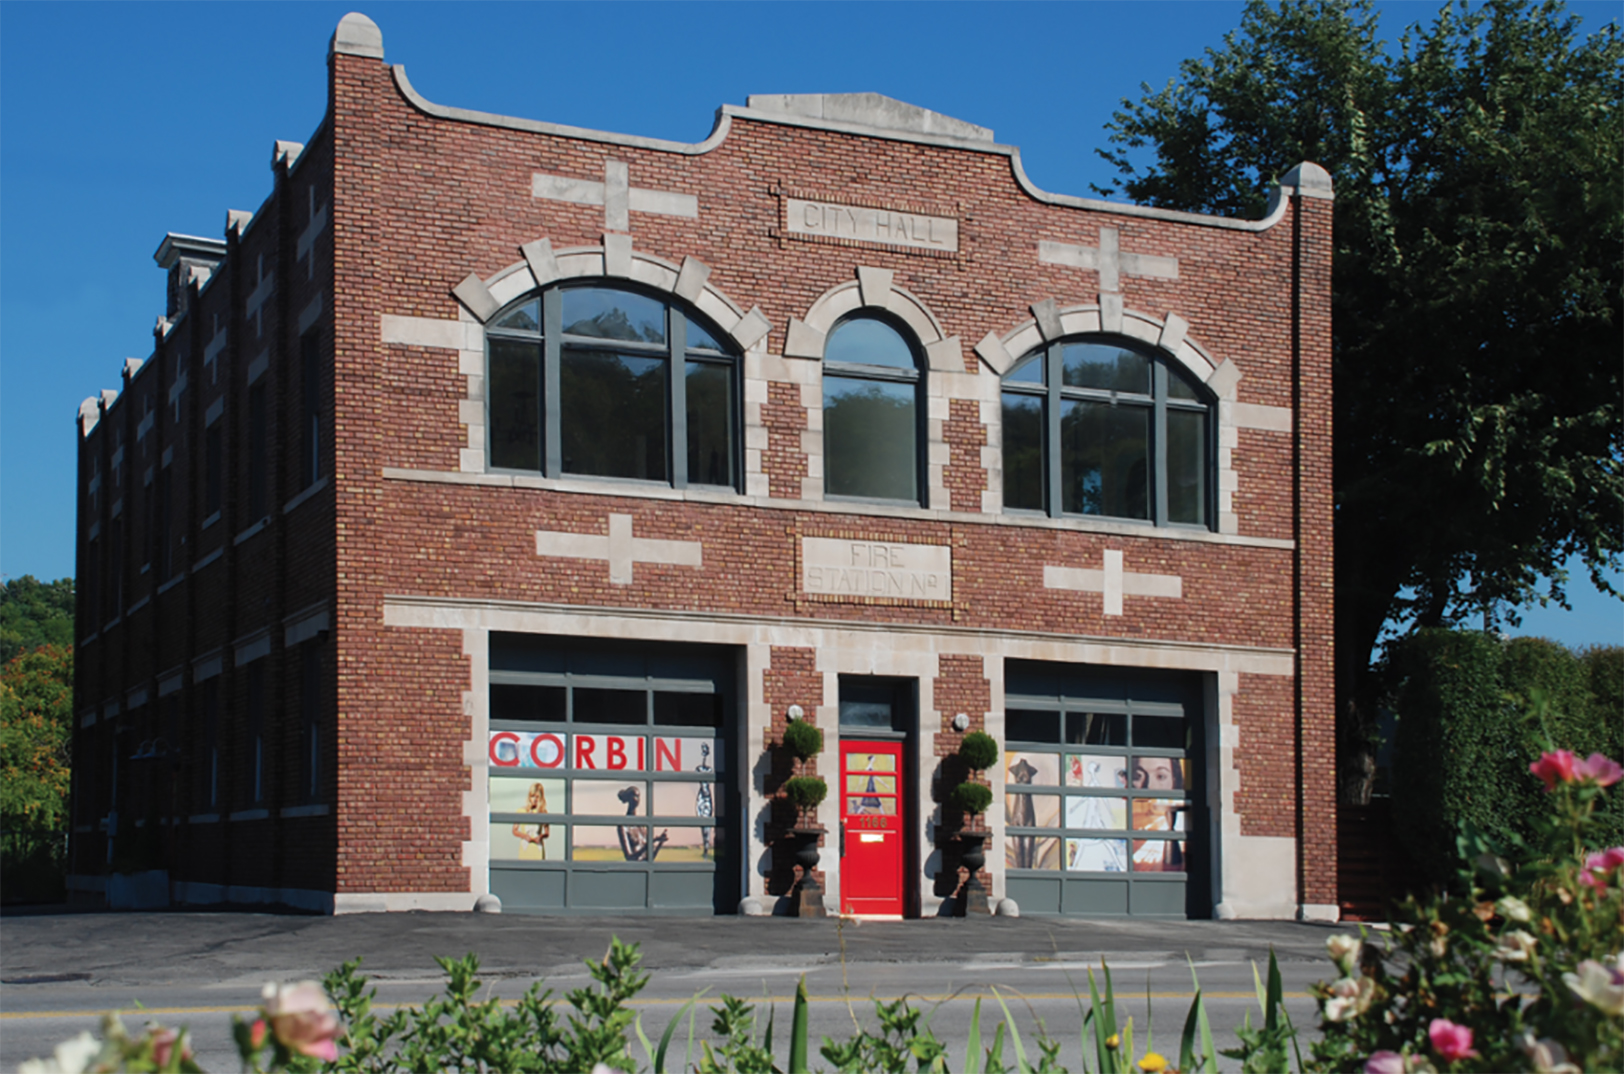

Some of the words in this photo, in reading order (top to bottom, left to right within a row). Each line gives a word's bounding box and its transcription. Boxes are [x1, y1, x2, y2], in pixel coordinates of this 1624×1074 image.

[803, 203, 862, 234] CITY
[874, 212, 944, 245] HALL
[850, 543, 905, 567] FIRE
[808, 566, 902, 596] STATION
[489, 731, 681, 772] CORBIN
[859, 816, 887, 829] 1166
